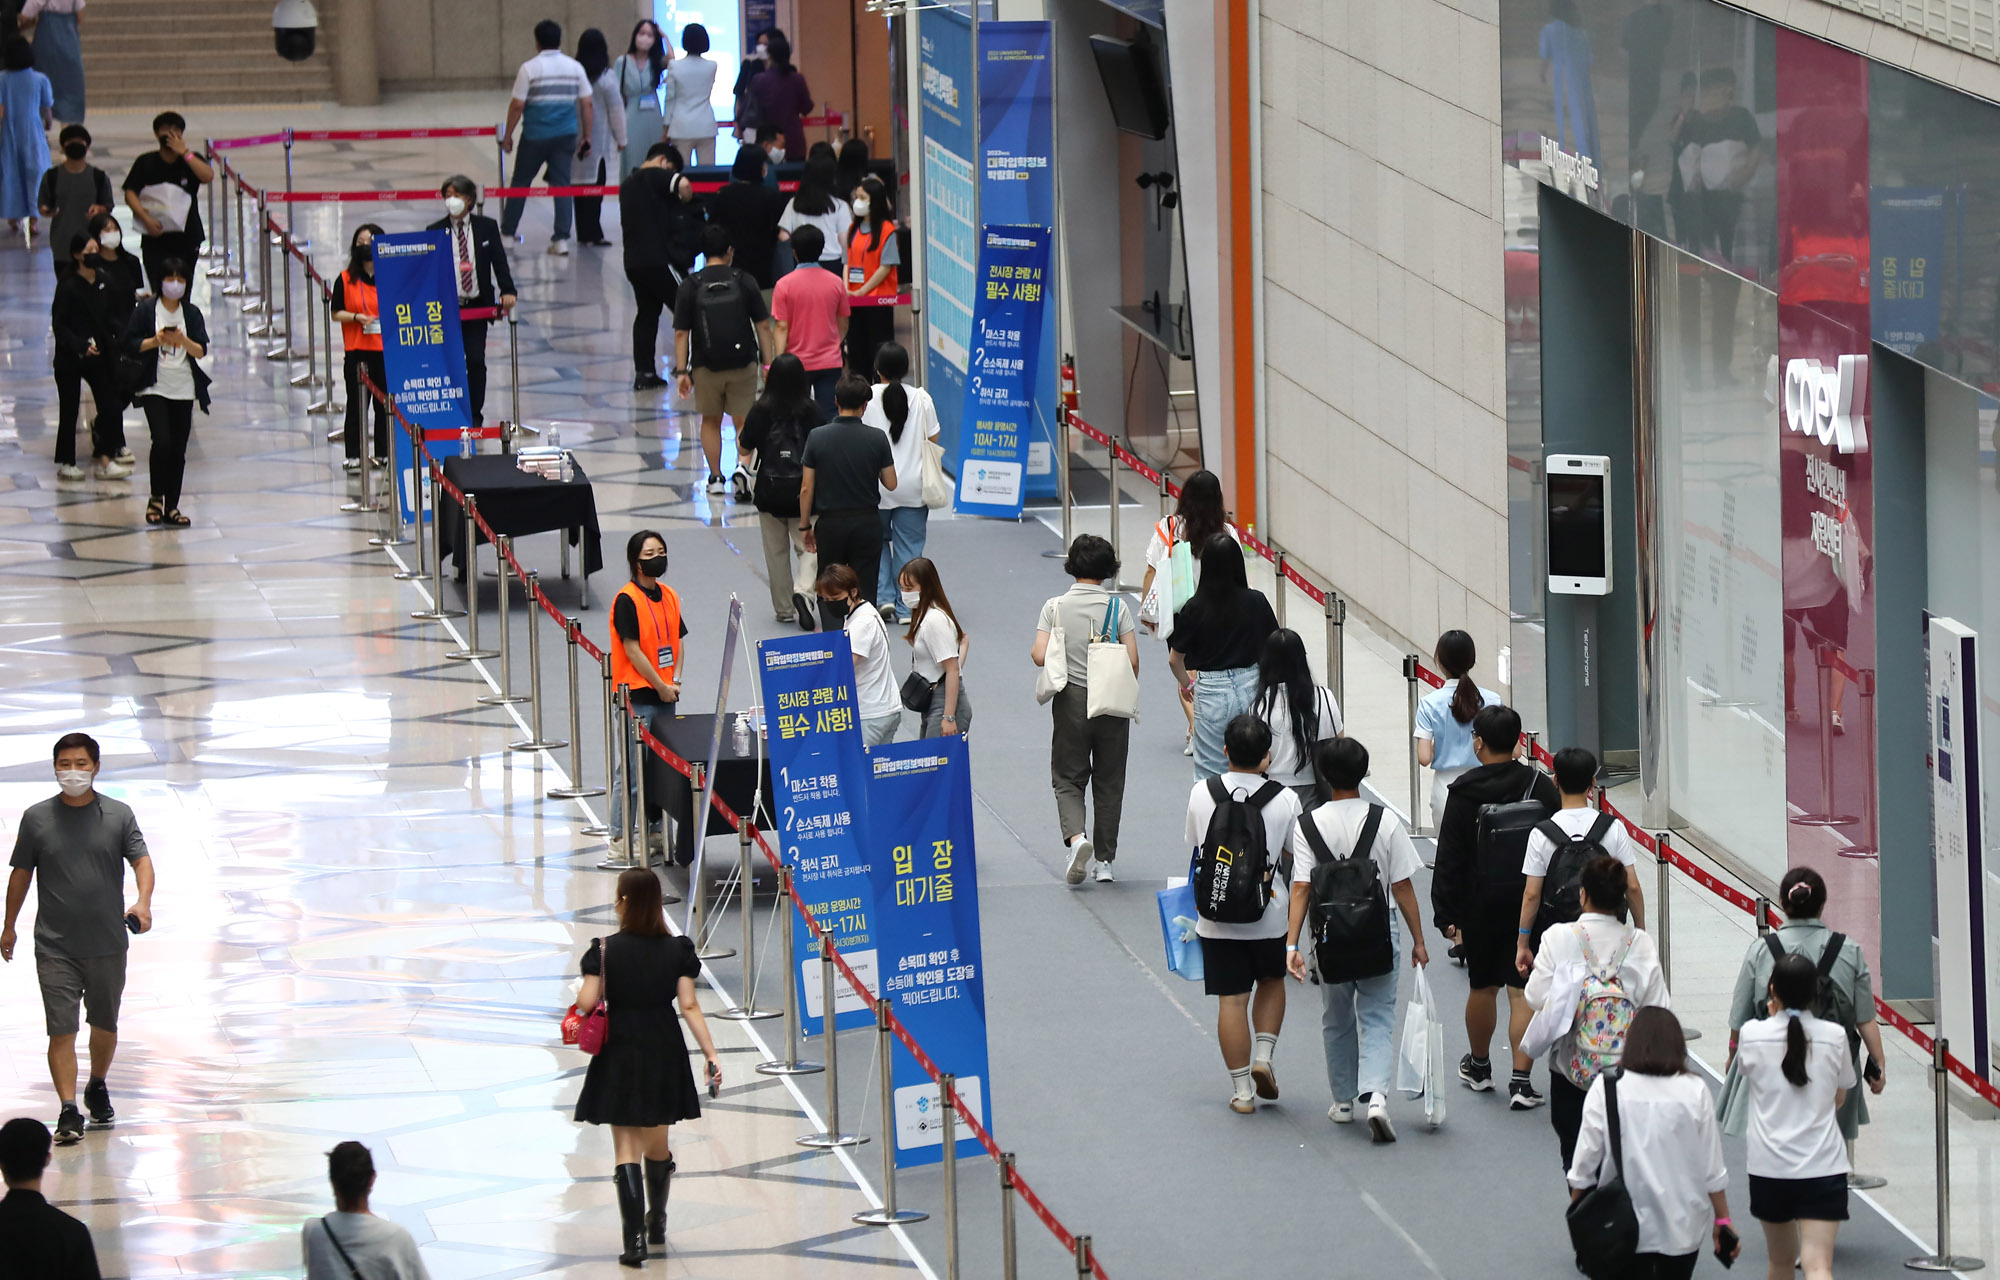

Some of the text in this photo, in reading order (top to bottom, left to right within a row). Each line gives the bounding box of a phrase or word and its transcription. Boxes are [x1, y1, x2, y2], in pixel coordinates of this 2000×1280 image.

[987, 157, 1047, 168] 대학입학정보
[990, 265, 1041, 280] 전시장 관람 시
[877, 295, 898, 304] coex
[986, 281, 1041, 302] 필수 사항!
[396, 301, 442, 324] 입 장
[399, 324, 444, 346] 대기줄
[980, 318, 986, 334] 1
[985, 329, 1020, 341] 마스크 착용
[974, 347, 985, 366] 2
[983, 357, 1024, 370] 손소독제 사용
[995, 388, 1008, 399] 금지
[1785, 355, 1856, 454] coex
[973, 433, 1018, 448] 10시-17시
[765, 650, 824, 666] 대학입학정보박람회
[777, 685, 848, 709] 전시장 관람 시
[778, 707, 853, 739] 필수 사항!
[873, 756, 938, 774] 대학입학정보박람회
[780, 767, 789, 788] 1
[790, 774, 838, 793] 마스크 착용
[792, 789, 841, 803] 반드시 착용 합니다.
[783, 806, 795, 832] 2
[796, 811, 851, 832] 손소독제 사용
[797, 828, 845, 841] 수시로 사용 합니다.
[800, 854, 839, 872] 취식 금지
[892, 839, 954, 875] 입 장
[802, 871, 818, 882] 전시장
[820, 870, 826, 879] 내
[827, 868, 843, 878] 취식은
[895, 873, 954, 906] 대기줄
[830, 897, 861, 913] 운영시간
[898, 948, 960, 971] 손목띠 확인 후
[886, 973, 913, 991] 손등에
[915, 969, 944, 986] 확인용
[946, 964, 975, 982] 도장을
[901, 985, 960, 1007] 찍어드립니다.
